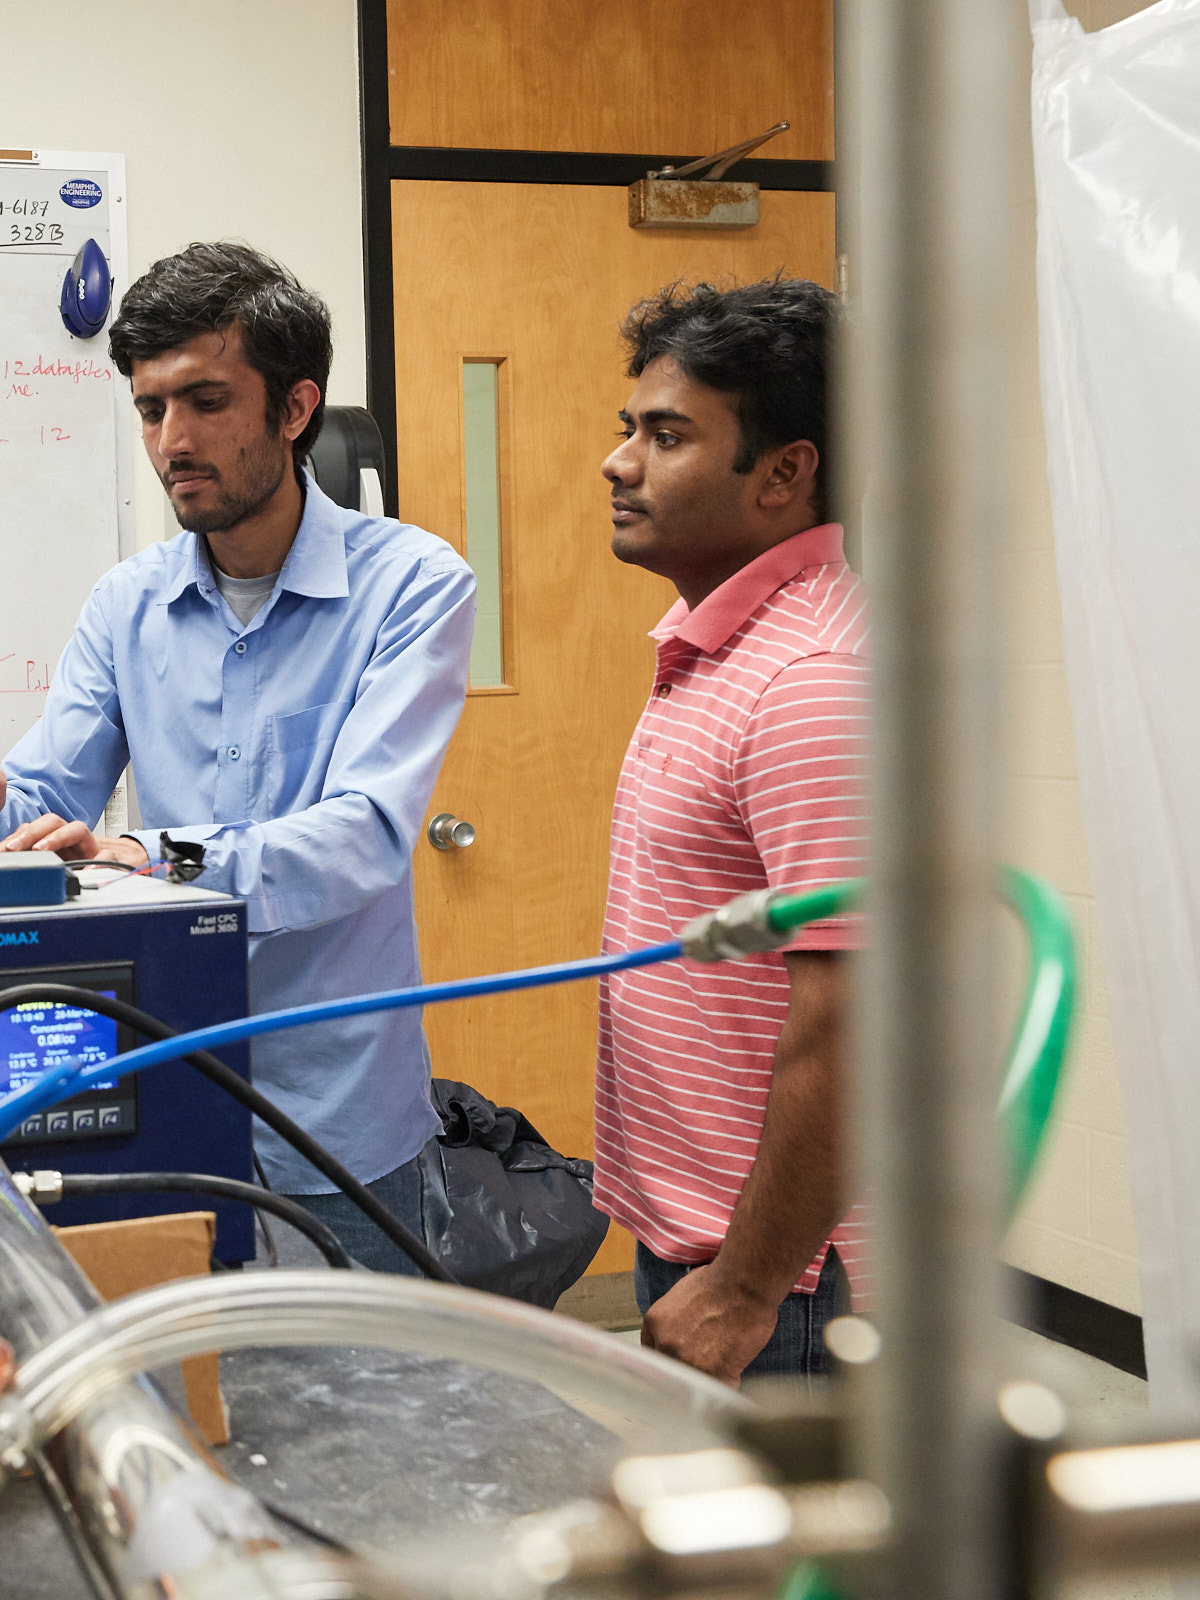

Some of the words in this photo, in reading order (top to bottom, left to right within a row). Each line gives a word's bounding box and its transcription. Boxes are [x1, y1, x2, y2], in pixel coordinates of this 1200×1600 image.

[60, 188, 102, 197] ENGINEERING
[217, 913, 238, 924] CPC
[26, 1121, 40, 1132] F1
[52, 1118, 67, 1130] F2
[78, 1116, 93, 1127] F3
[104, 1114, 118, 1124] F4
